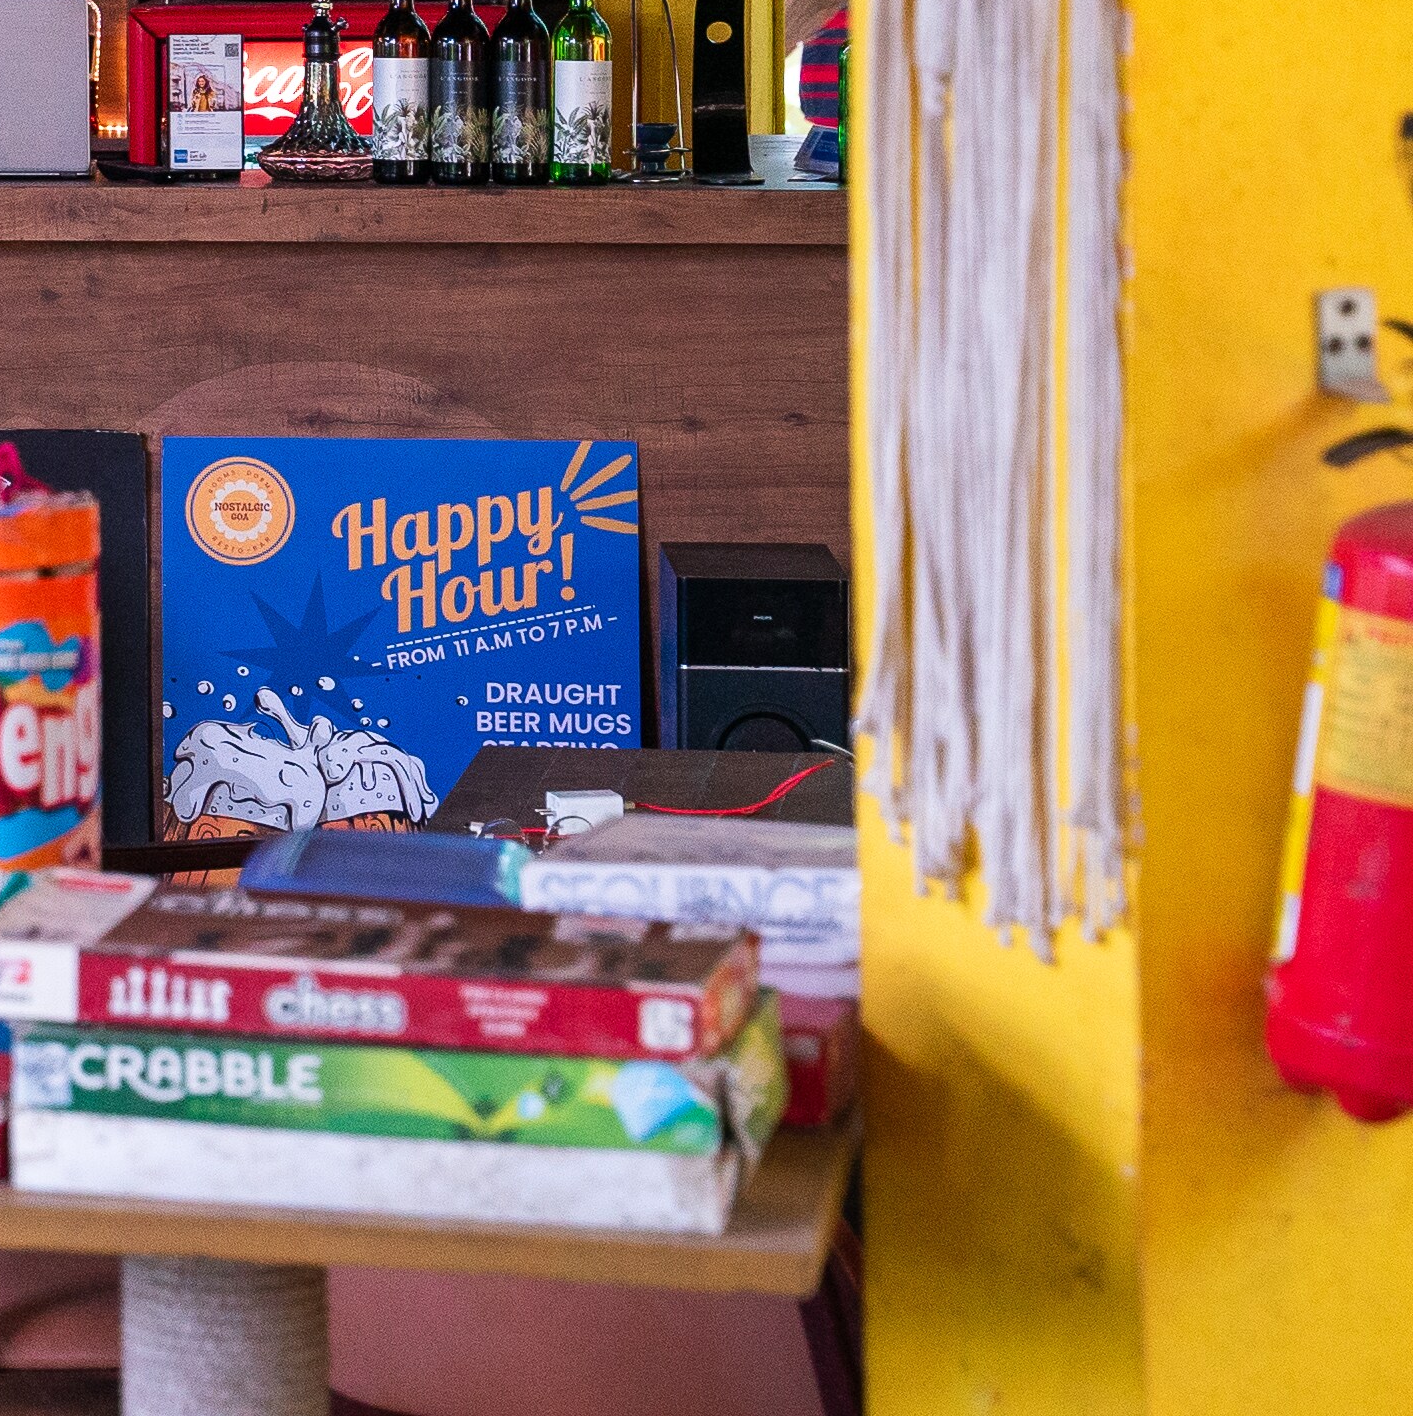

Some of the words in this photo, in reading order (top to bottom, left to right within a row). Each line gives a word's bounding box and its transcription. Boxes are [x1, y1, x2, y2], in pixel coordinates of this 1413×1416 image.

[214, 502, 271, 512] NOSTALGIC
[231, 513, 249, 521] GOA
[331, 486, 565, 575] Happy
[381, 533, 577, 634] Hour!
[386, 643, 446, 671] FROM
[453, 639, 470, 657] 11
[475, 631, 513, 655] A.M
[516, 625, 545, 646] TO
[548, 621, 560, 640] 7
[566, 614, 603, 636] P.M
[486, 682, 622, 707] DRAUGHT
[476, 711, 539, 734] BEER
[548, 711, 633, 736] MUGS
[263, 975, 408, 1037] chess
